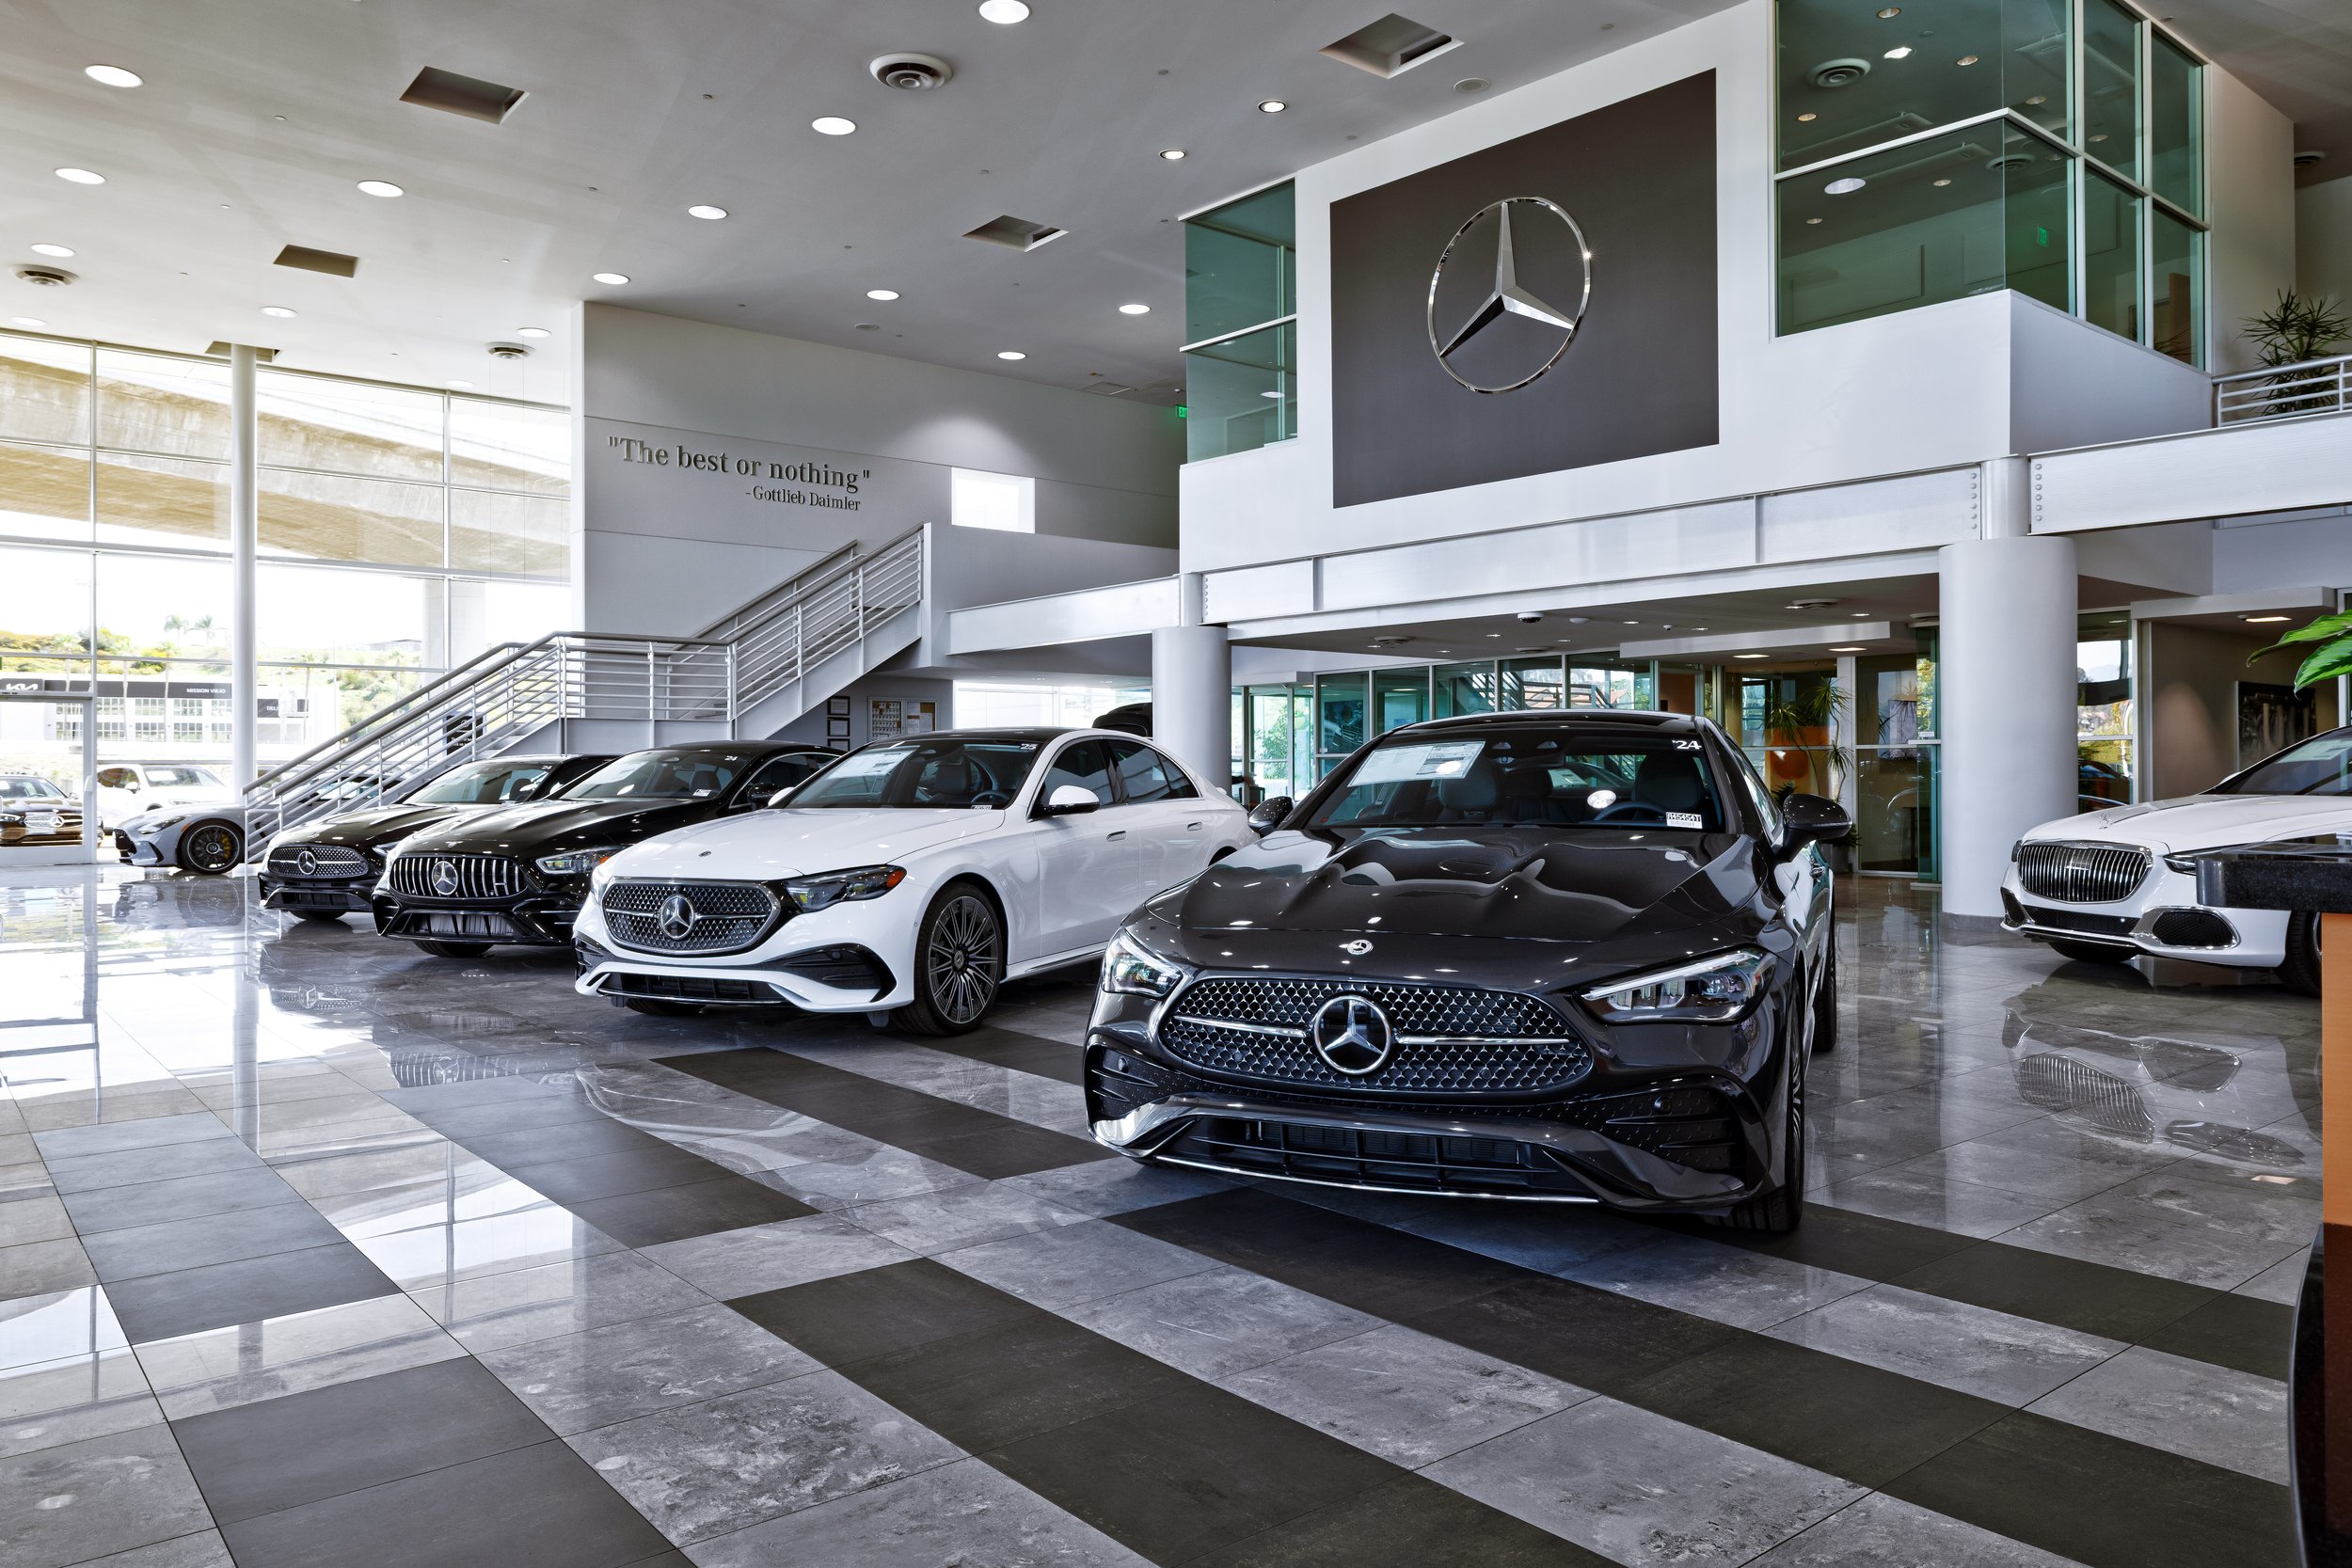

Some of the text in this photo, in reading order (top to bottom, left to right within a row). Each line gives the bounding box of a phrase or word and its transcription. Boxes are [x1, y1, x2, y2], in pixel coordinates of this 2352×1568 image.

[608, 436, 870, 494] "The best or nothing"
[745, 484, 861, 512] -Gottlieb Daimler
